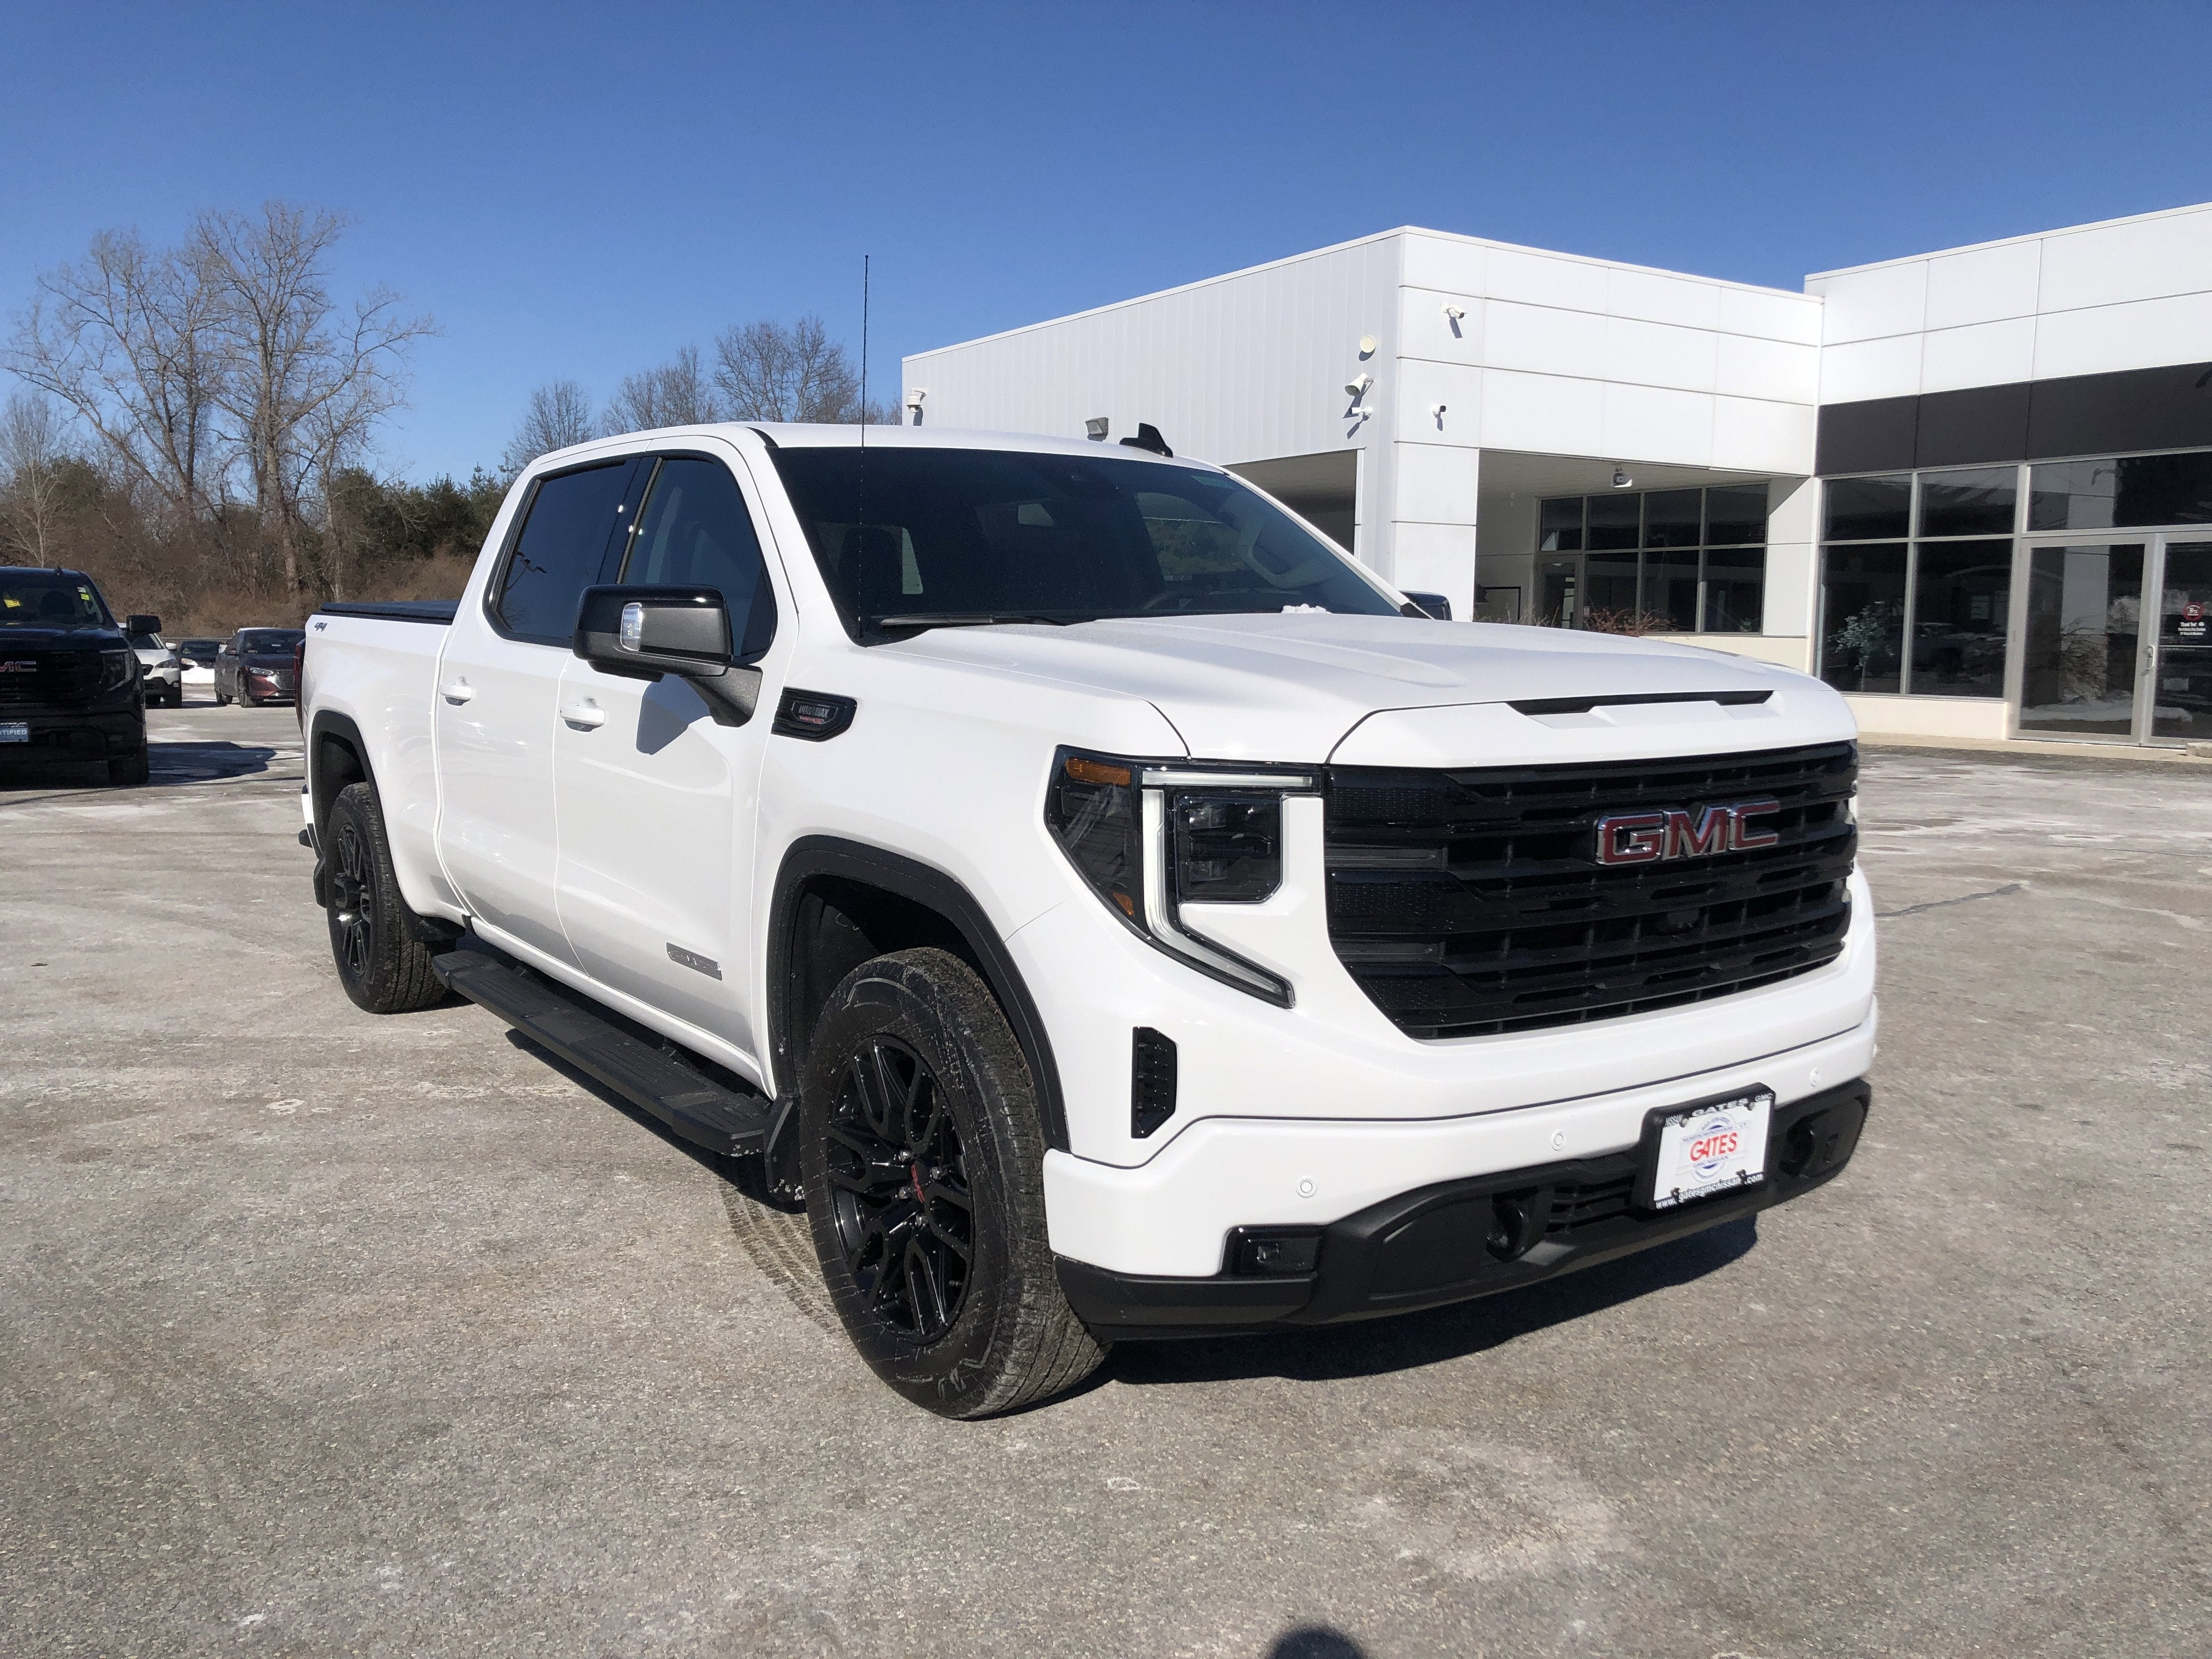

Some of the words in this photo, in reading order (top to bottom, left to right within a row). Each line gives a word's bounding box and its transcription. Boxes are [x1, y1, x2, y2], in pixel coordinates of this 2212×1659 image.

[0, 661, 37, 672] MC
[1595, 800, 1780, 866] GMC
[1692, 1098, 1749, 1117] GATES
[1755, 1093, 1773, 1102] GMC
[1690, 1132, 1737, 1161] GATES
[1656, 1173, 1764, 1210] www.gatesgmcnissan.com
